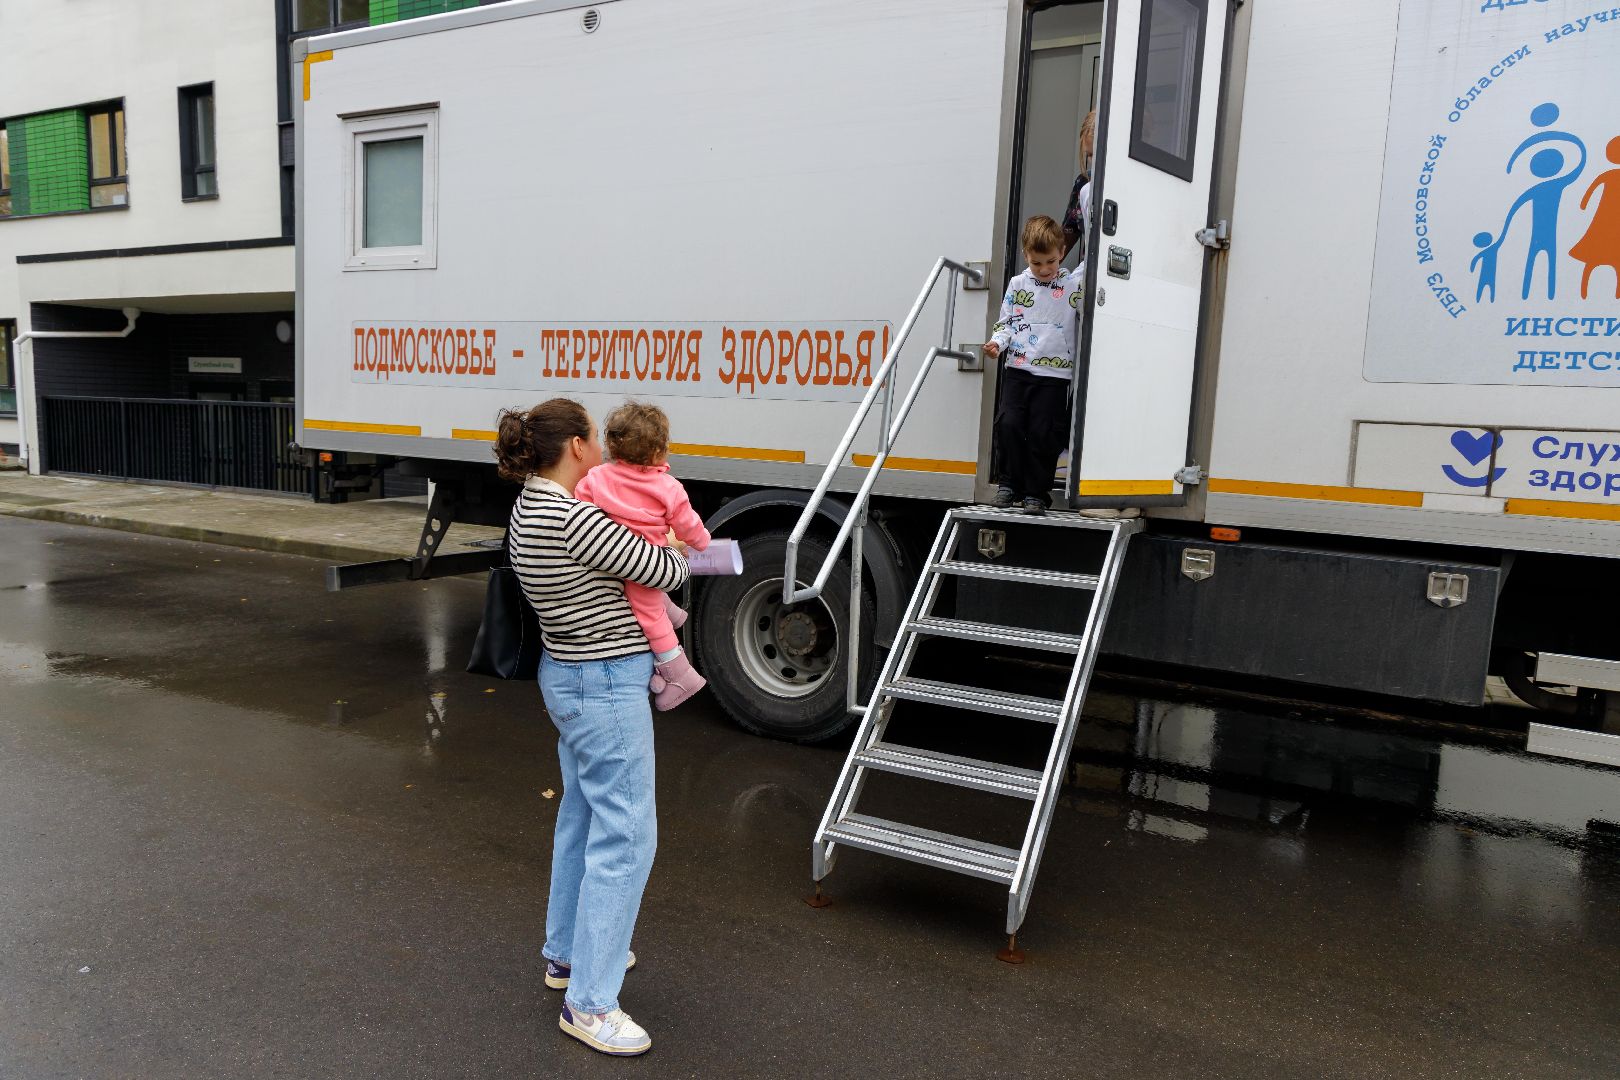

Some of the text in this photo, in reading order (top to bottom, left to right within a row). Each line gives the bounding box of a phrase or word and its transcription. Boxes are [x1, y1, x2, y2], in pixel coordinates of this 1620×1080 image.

[1448, 45, 1532, 122] области
[1415, 134, 1447, 264] Московской
[1427, 272, 1467, 318] ГБУЗ
[353, 327, 496, 381] ПОДМОСКОВЬЕ
[541, 329, 703, 381] ТЕРРИТОРИЯ
[1512, 350, 1620, 372] ДЕТС
